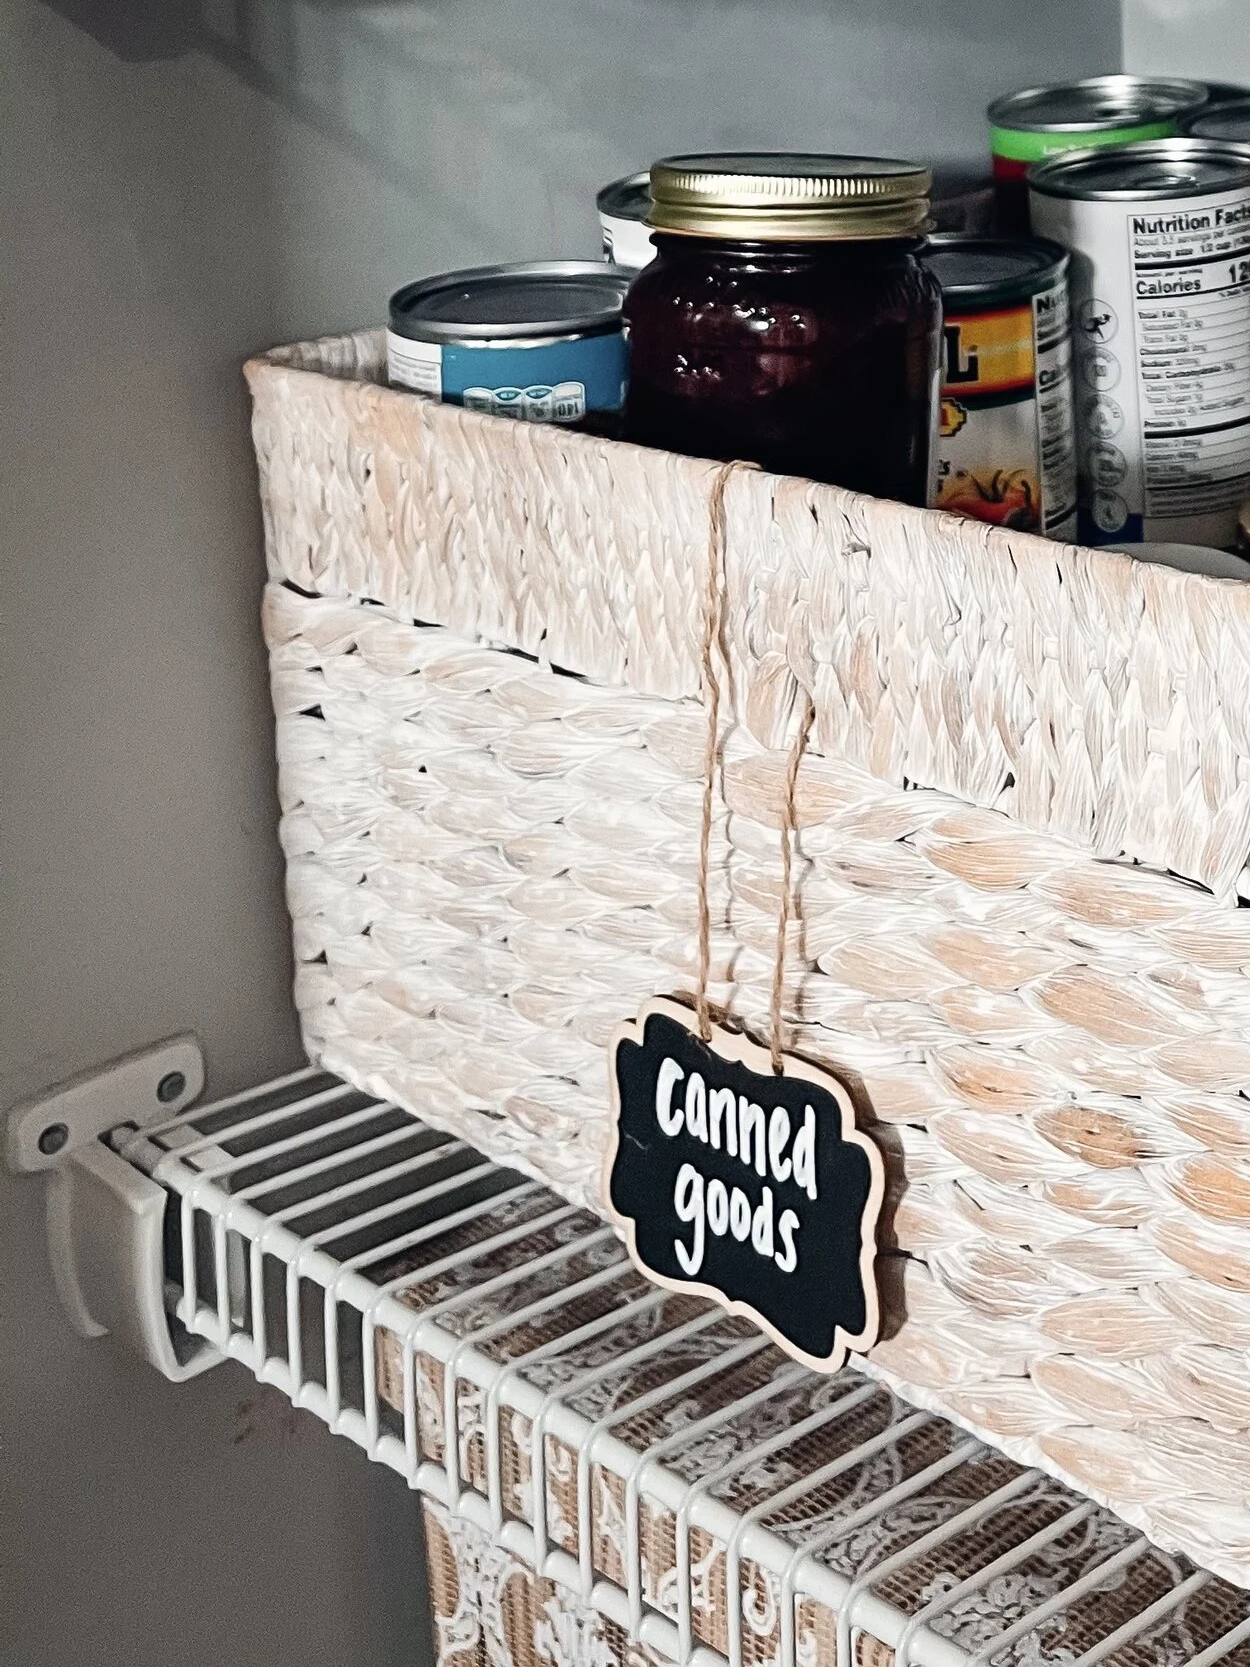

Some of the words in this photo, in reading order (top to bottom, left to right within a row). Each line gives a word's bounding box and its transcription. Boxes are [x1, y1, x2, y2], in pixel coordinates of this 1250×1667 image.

[1133, 213, 1210, 234] Nutrition
[1136, 277, 1201, 295] Calories
[656, 1057, 818, 1201] canned
[674, 1163, 800, 1276] goods
